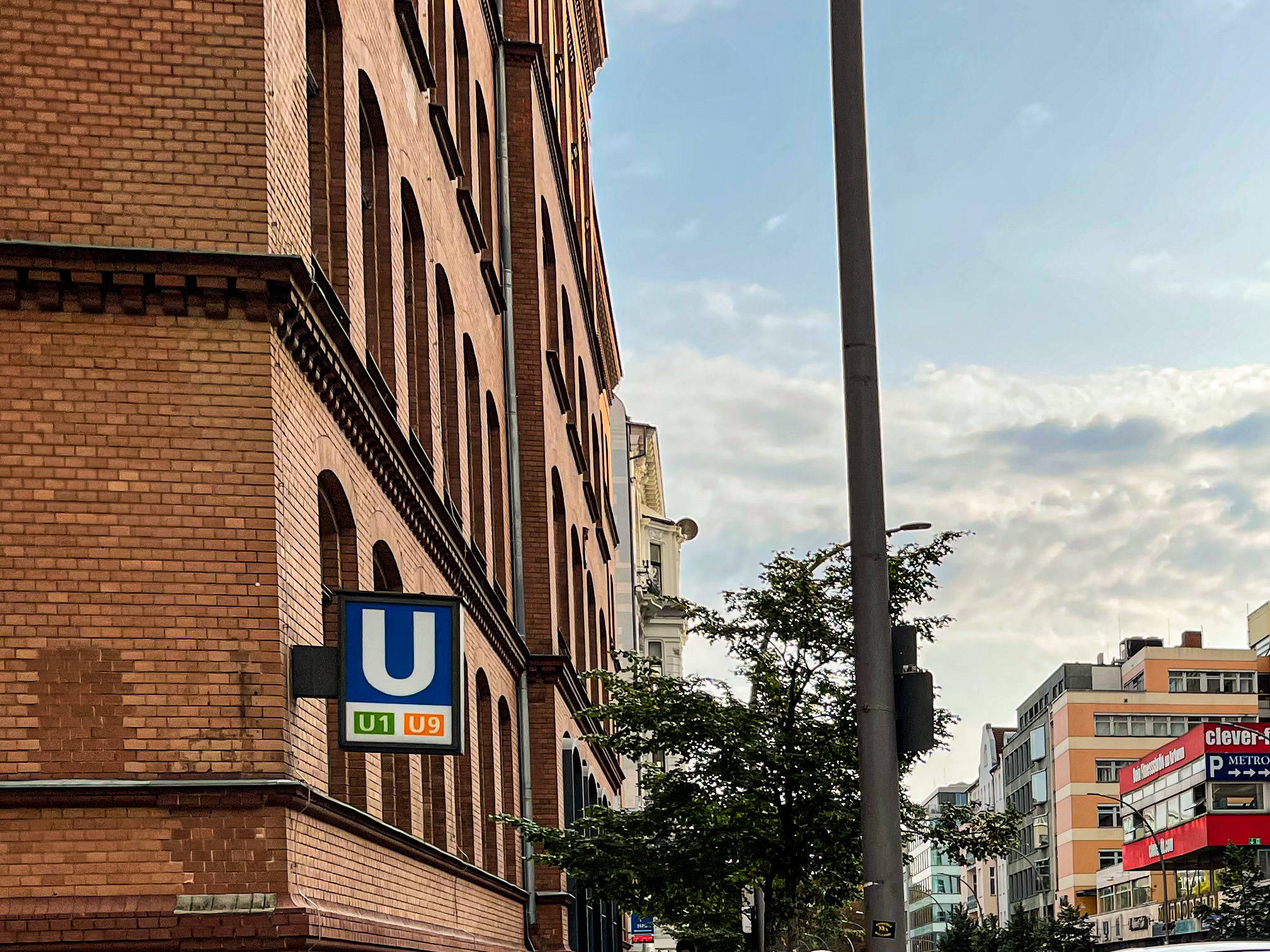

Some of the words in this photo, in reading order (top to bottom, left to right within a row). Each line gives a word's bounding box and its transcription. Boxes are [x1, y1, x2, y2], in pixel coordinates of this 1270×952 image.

[362, 608, 436, 697] U
[359, 714, 389, 732] U1
[409, 715, 441, 734] U9
[1209, 755, 1224, 778] P
